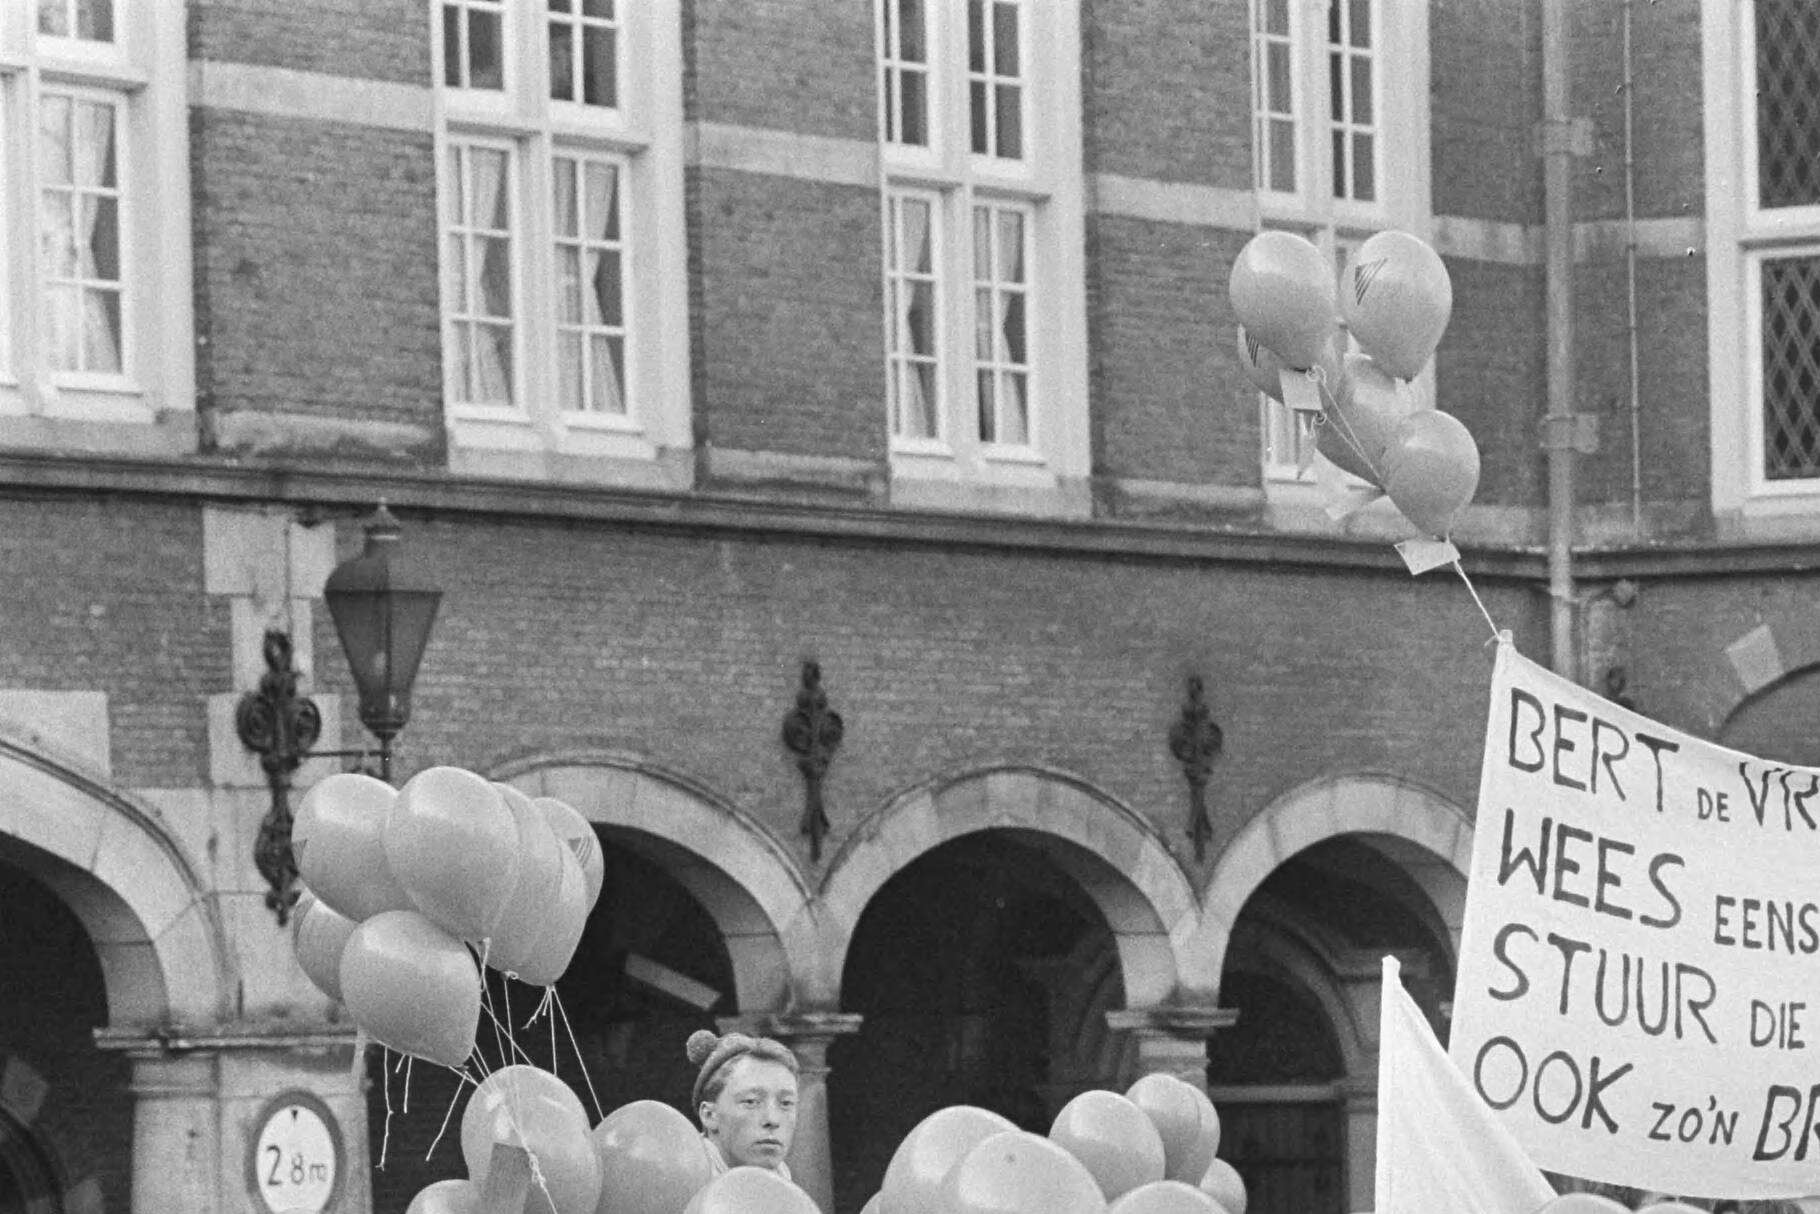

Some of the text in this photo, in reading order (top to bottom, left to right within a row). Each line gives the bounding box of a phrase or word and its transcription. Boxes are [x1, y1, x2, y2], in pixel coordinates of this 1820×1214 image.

[1508, 687, 1680, 812] BERT
[1697, 787, 1730, 822] DE
[1498, 808, 1686, 930] WEES
[1714, 895, 1819, 954] EENS
[1488, 923, 1717, 1044] STUUR
[1750, 1000, 1806, 1050] DIE
[1474, 1036, 1634, 1135] OOK
